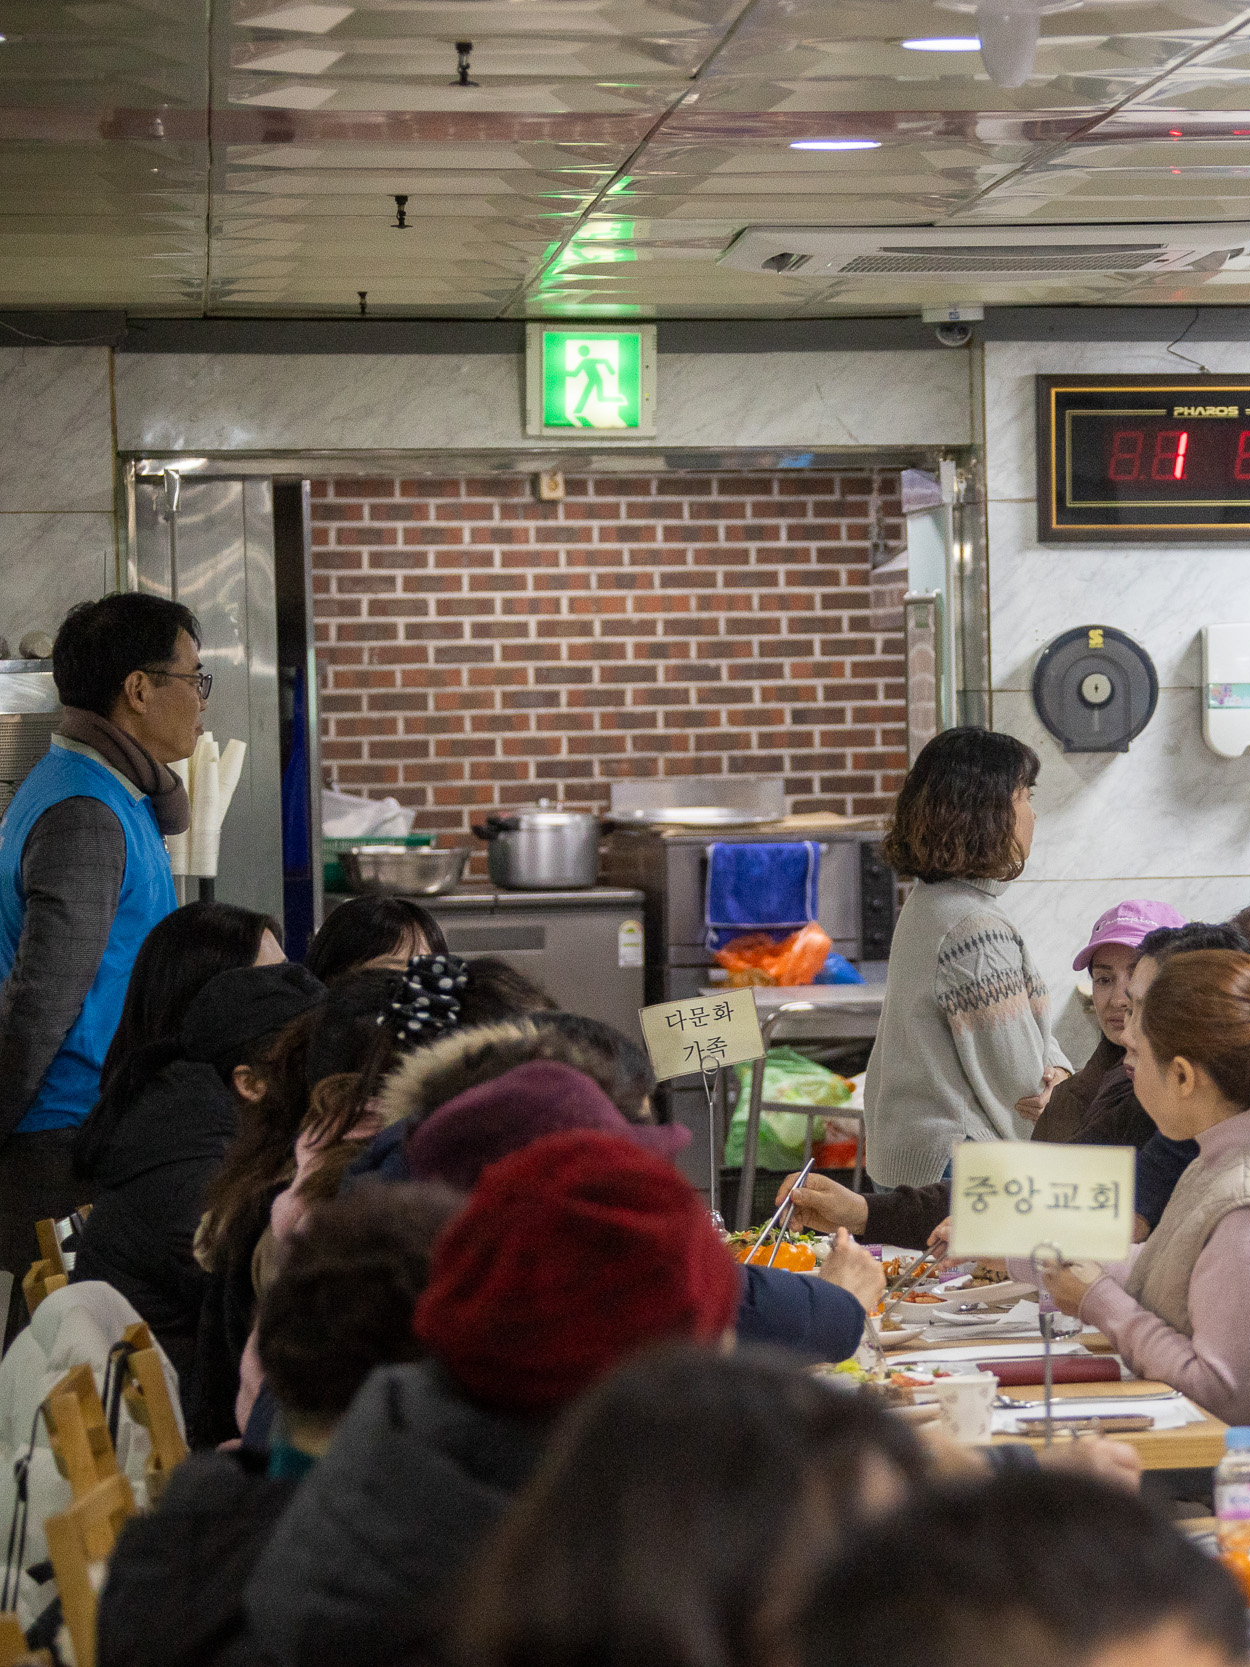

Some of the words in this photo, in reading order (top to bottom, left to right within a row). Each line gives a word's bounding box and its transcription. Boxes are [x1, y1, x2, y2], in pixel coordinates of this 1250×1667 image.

[1173, 406, 1239, 417] PHAROS
[664, 1001, 734, 1031] 다문화
[683, 1036, 728, 1062] 가족
[963, 1175, 1119, 1219] 중앙교회
